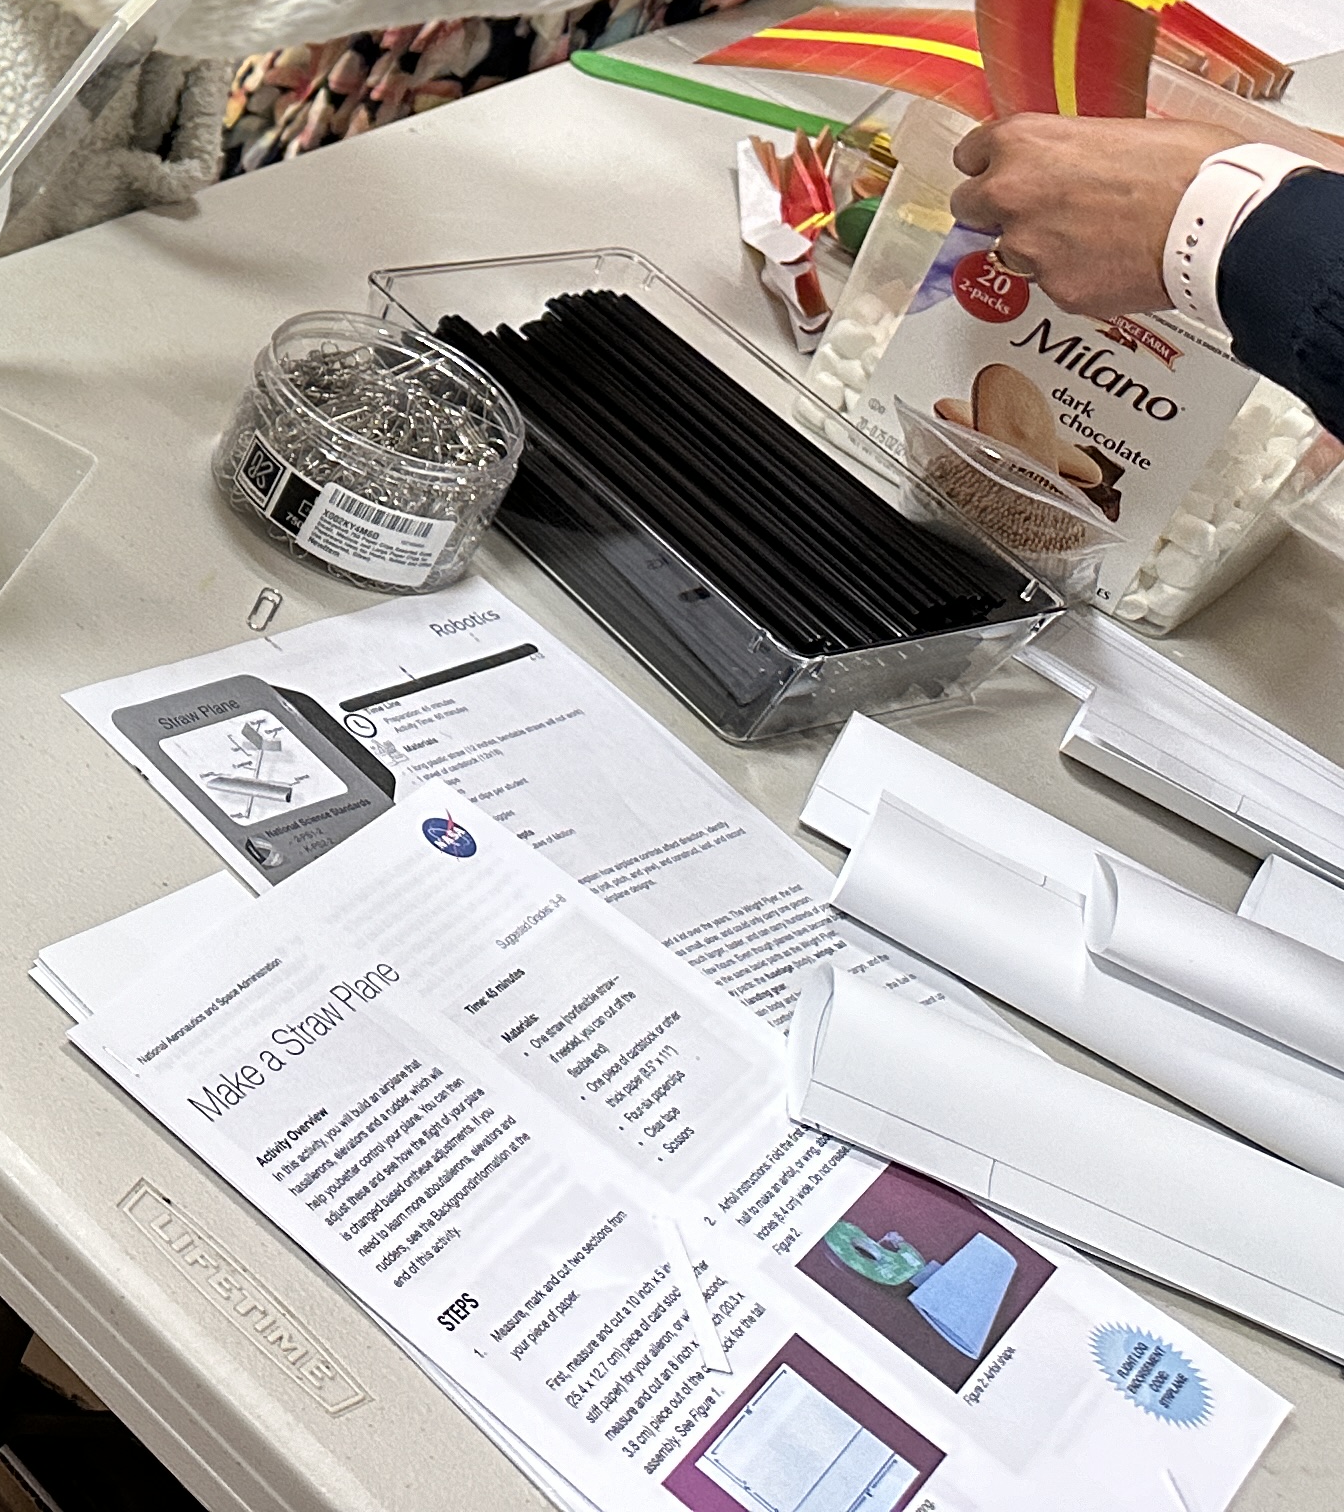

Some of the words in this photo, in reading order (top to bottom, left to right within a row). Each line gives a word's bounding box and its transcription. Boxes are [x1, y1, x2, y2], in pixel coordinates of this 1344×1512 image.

[976, 265, 1011, 295] 20
[959, 278, 1011, 314] 2-packs
[1141, 332, 1170, 358] FARM
[1009, 318, 1179, 421] Milano
[1051, 387, 1095, 418] dark
[1059, 411, 1151, 470] chocolate
[429, 610, 500, 637] Robotics
[158, 711, 200, 730] Straw
[197, 699, 240, 718] Plane
[264, 821, 301, 838] National
[434, 826, 466, 849] NASA
[330, 963, 399, 1011] Plane
[494, 968, 525, 992] minutes
[136, 1040, 168, 1065] National
[165, 1013, 206, 1044] Aeronautics
[203, 1002, 219, 1016] and
[215, 988, 240, 1006] Space
[236, 958, 282, 991] Administration
[271, 1002, 343, 1055] Straw
[259, 1050, 286, 1071] a
[187, 1065, 264, 1121] Make
[271, 1171, 285, 1182] In
[280, 1159, 300, 1175] this
[297, 1138, 329, 1162] activity,
[324, 1125, 342, 1142] you
[338, 1112, 354, 1127] will
[349, 1098, 372, 1117] build
[368, 1092, 382, 1103] an
[378, 1070, 408, 1095] airplane
[403, 1058, 422, 1073] that
[365, 1116, 383, 1133] and
[379, 1113, 389, 1121] a
[643, 1119, 666, 1137] Clear
[256, 1138, 291, 1167] Activity
[286, 1107, 328, 1141] Overview
[305, 1193, 327, 1211] help
[358, 1141, 386, 1167] control
[383, 1128, 401, 1148] your
[418, 1100, 437, 1113] You
[433, 1089, 450, 1103] can
[444, 1078, 465, 1092] then
[662, 1126, 694, 1153] Scissors
[324, 1202, 351, 1226] adjust
[346, 1185, 371, 1206] these
[368, 1171, 385, 1188] and
[382, 1161, 399, 1176] see
[393, 1147, 414, 1164] how
[409, 1137, 427, 1150] the
[421, 1121, 445, 1140] flight
[440, 1113, 451, 1125] of
[448, 1102, 466, 1121] your
[463, 1088, 485, 1108] plane
[473, 1348, 486, 1358] 1.
[490, 1310, 529, 1342] Measure,
[524, 1290, 547, 1310] mark
[542, 1274, 560, 1292] and
[556, 1263, 572, 1279] cut
[566, 1251, 585, 1267] two
[581, 1224, 613, 1254] sections
[606, 1210, 627, 1227] from
[651, 1276, 661, 1284] x
[654, 1269, 666, 1279] 5
[151, 1213, 335, 1389] LIFETIME
[625, 1295, 641, 1308] 10
[636, 1281, 655, 1299] inch
[437, 1292, 481, 1333] STEPS
[510, 1339, 530, 1361] your
[527, 1319, 550, 1344] piece
[547, 1308, 558, 1322] of
[555, 1290, 580, 1316] paper.
[609, 1311, 626, 1327] cut
[621, 1306, 632, 1315] a
[595, 1323, 613, 1342] and
[566, 1339, 599, 1372] measure
[545, 1370, 571, 1391] First,
[643, 1436, 680, 1474] assembly.
[674, 1419, 695, 1437] See
[688, 1395, 716, 1422] Figure
[710, 1387, 724, 1397] 1.
